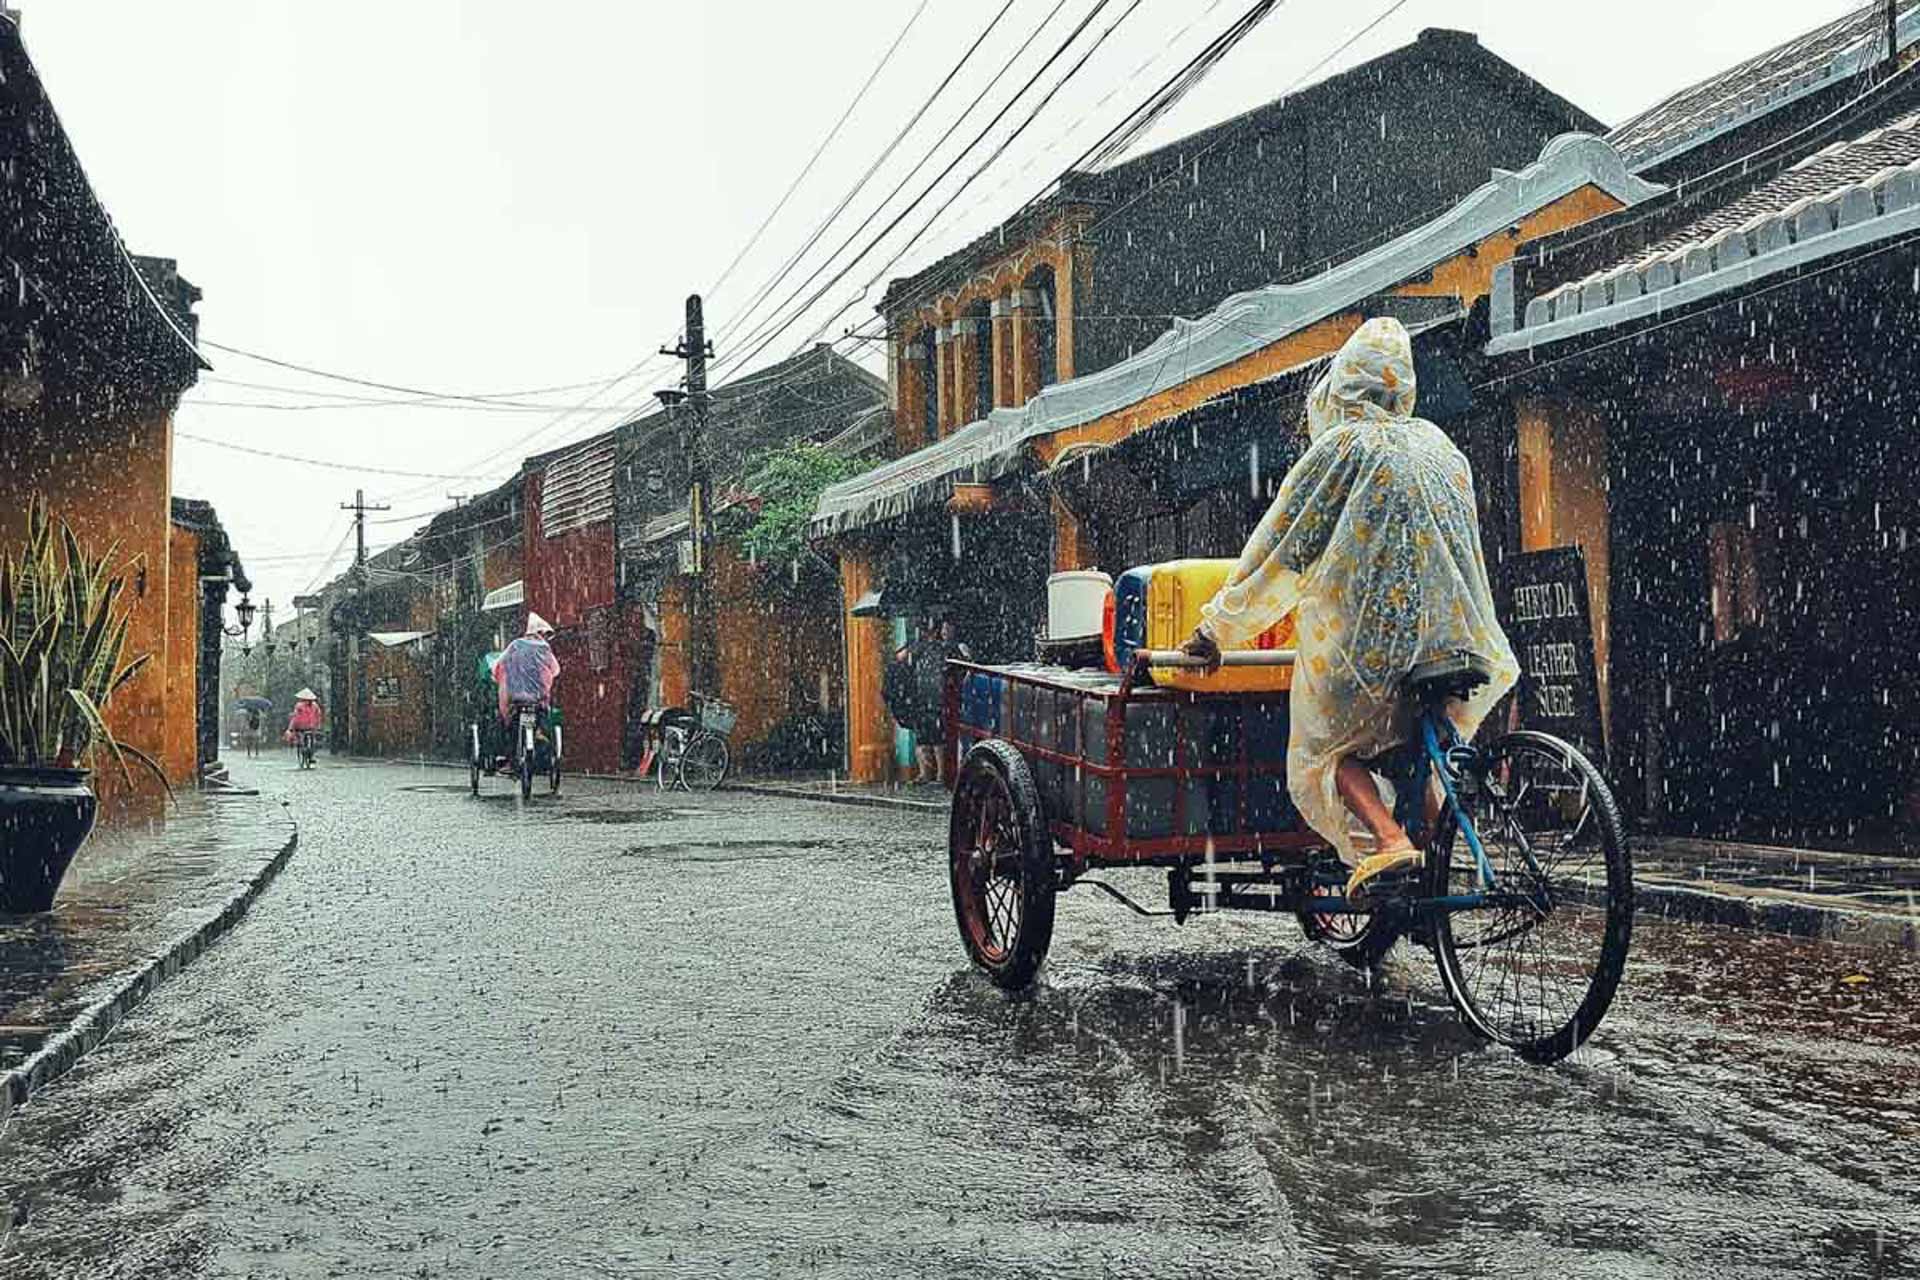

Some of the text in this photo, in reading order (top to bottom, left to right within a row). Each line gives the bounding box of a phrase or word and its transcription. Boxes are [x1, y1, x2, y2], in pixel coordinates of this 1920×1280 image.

[1553, 581, 1579, 617] DA
[1527, 643, 1578, 677] LEATHER
[1539, 684, 1575, 717] SUEDE
